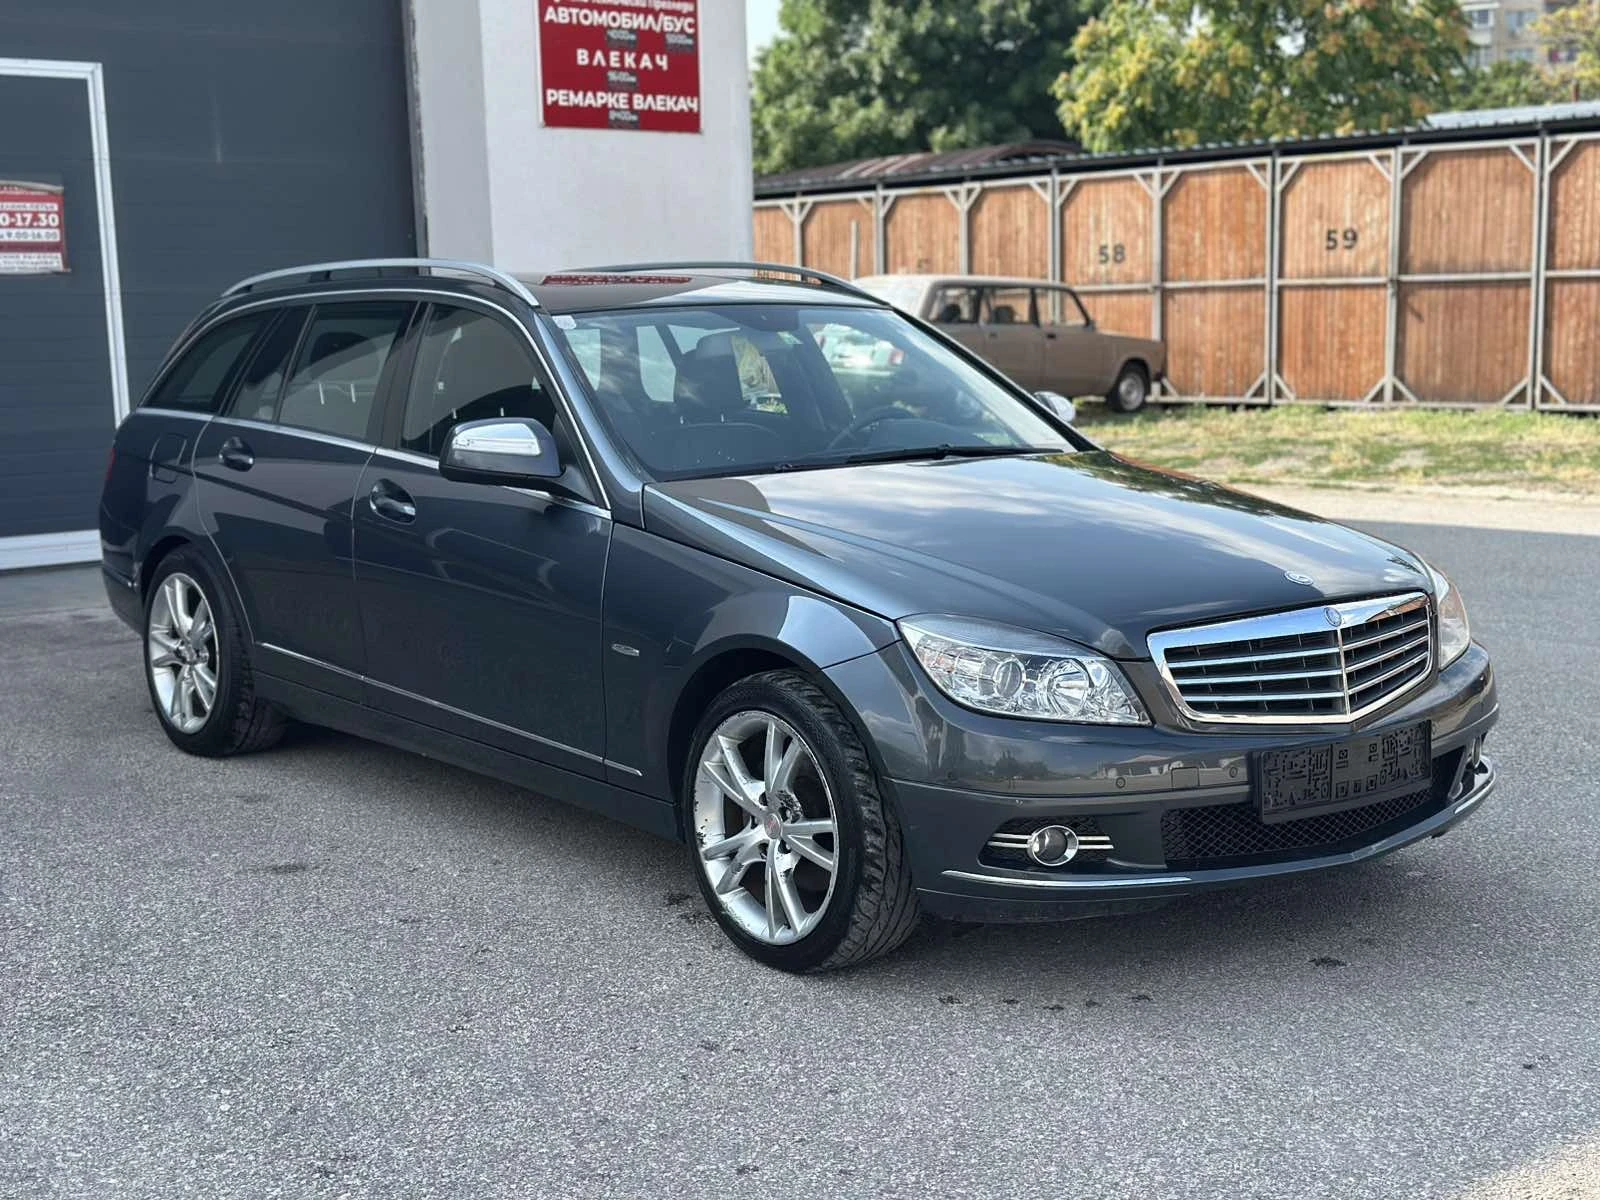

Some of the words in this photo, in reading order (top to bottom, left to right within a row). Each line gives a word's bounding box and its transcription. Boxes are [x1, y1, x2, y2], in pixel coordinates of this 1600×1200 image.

[544, 6, 696, 34] АВТОМОБИЛ/БУС
[576, 48, 669, 71] ВЛЕКАЧ
[545, 89, 630, 110] РЕМАРКЕ
[632, 94, 699, 113] ВЛЕКАЧ
[1325, 228, 1359, 251] 59
[1098, 244, 1126, 265] 58
